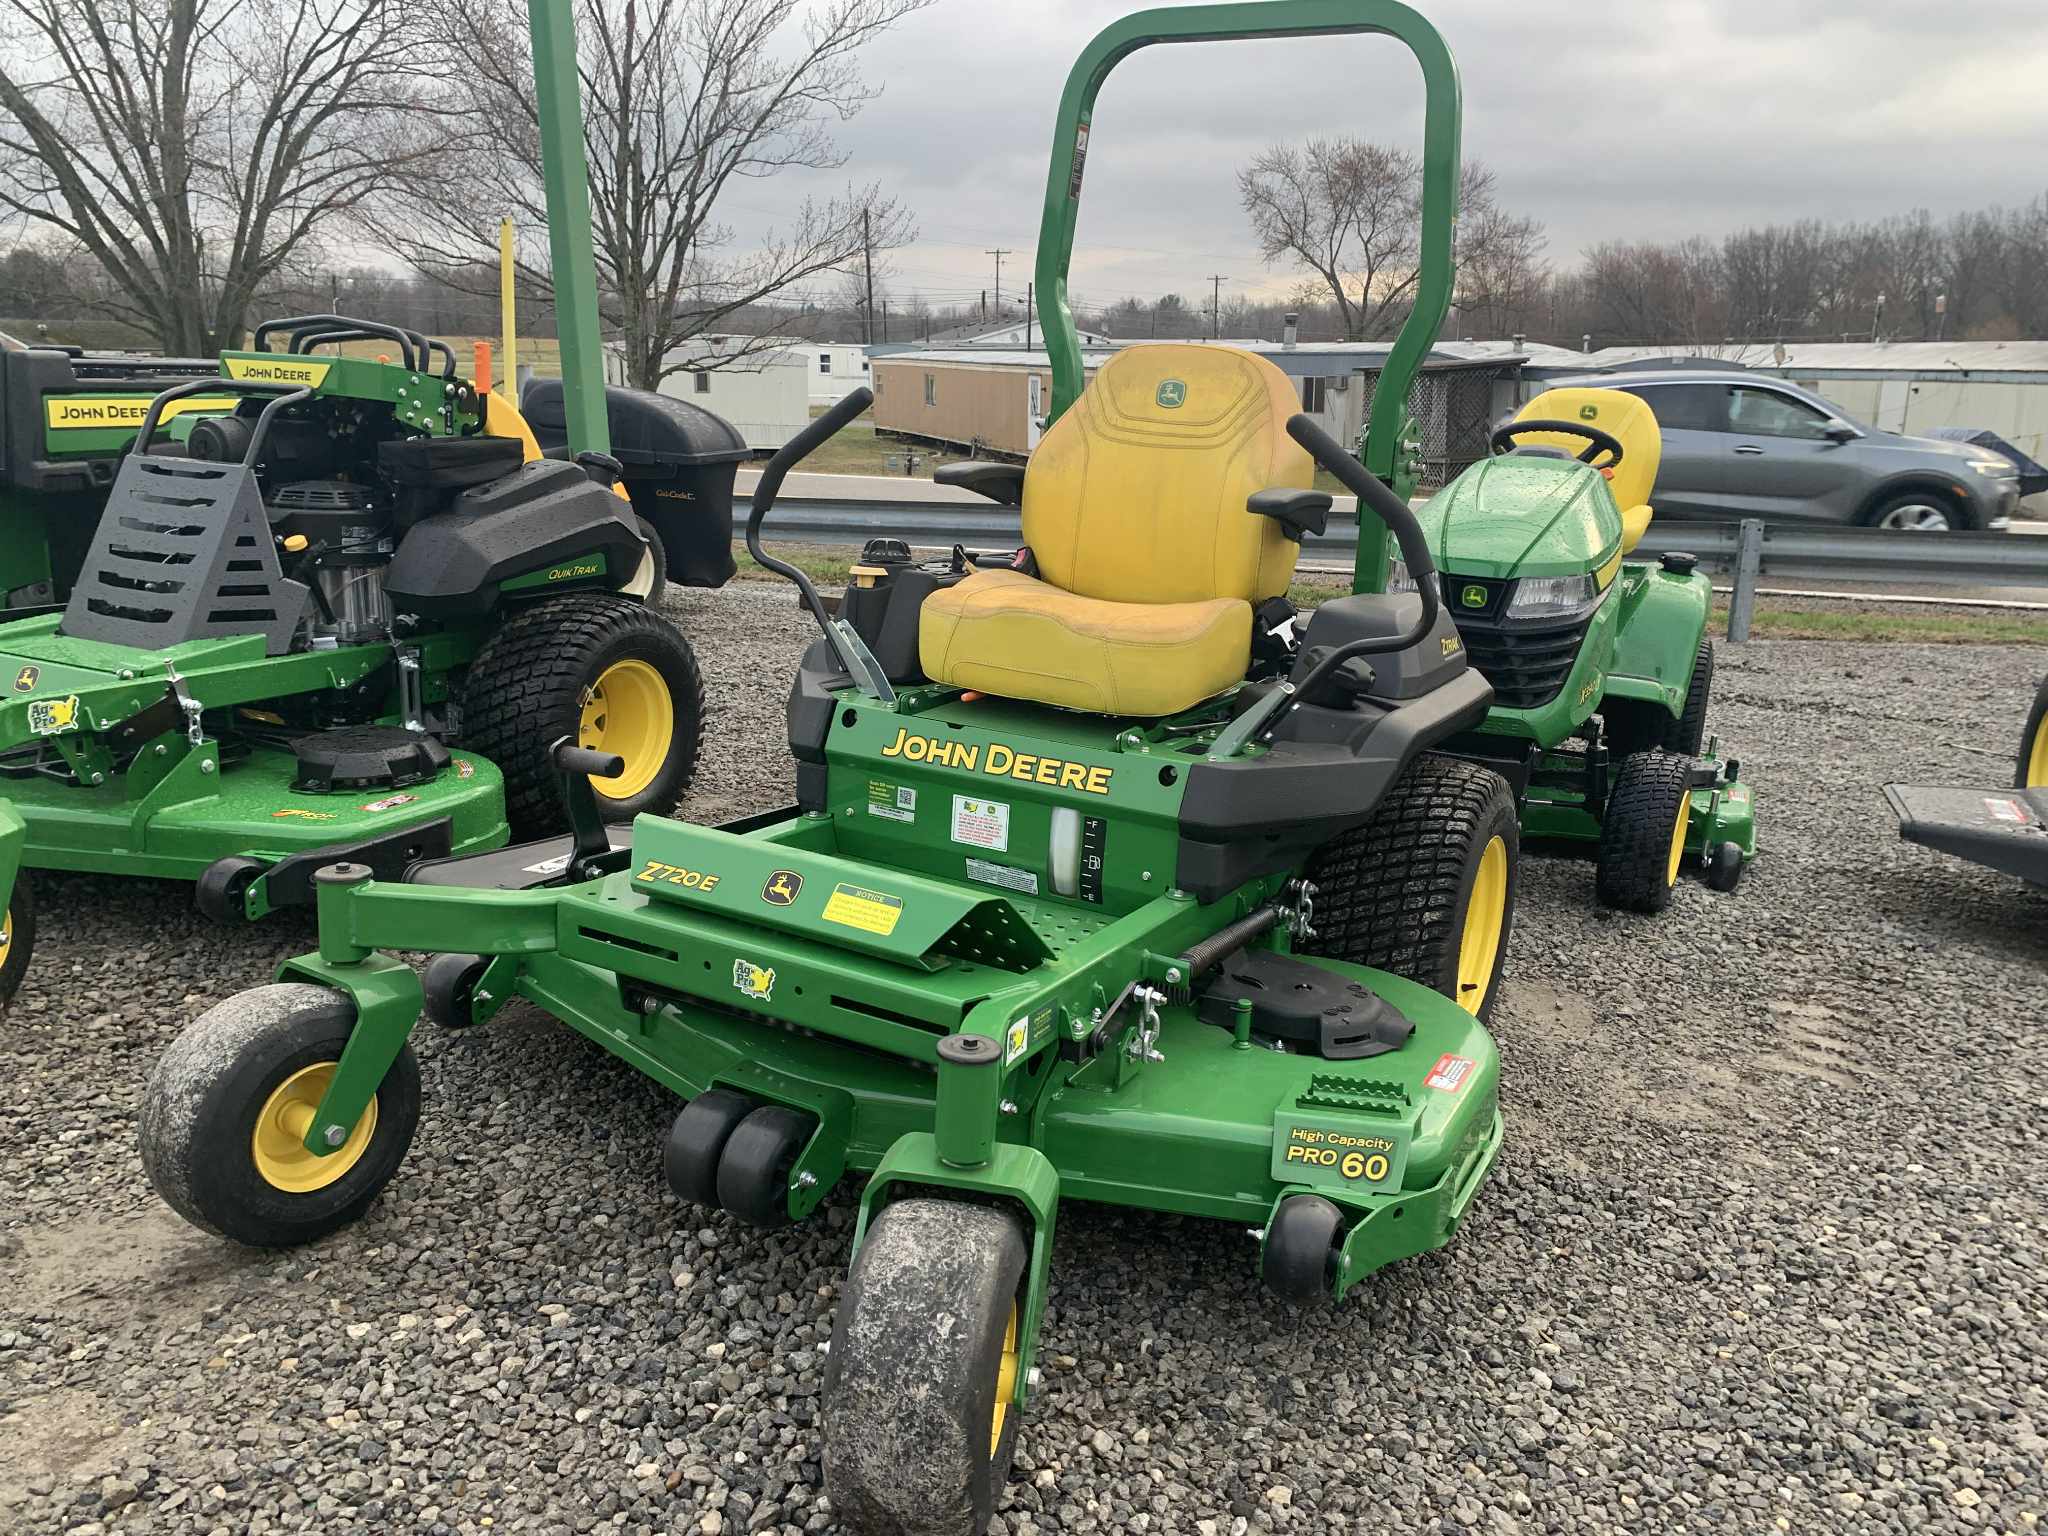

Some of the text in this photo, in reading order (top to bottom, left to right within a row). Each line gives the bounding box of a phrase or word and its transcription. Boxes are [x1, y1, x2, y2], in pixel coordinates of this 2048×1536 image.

[242, 366, 312, 381] JOHN DEERE
[60, 405, 149, 419] JOHN DEER
[881, 728, 1113, 795] JOHN DEERE
[855, 890, 886, 903] NOTICE
[1291, 1128, 1393, 1152] High Capacity
[1286, 1145, 1390, 1181] PRO 60
